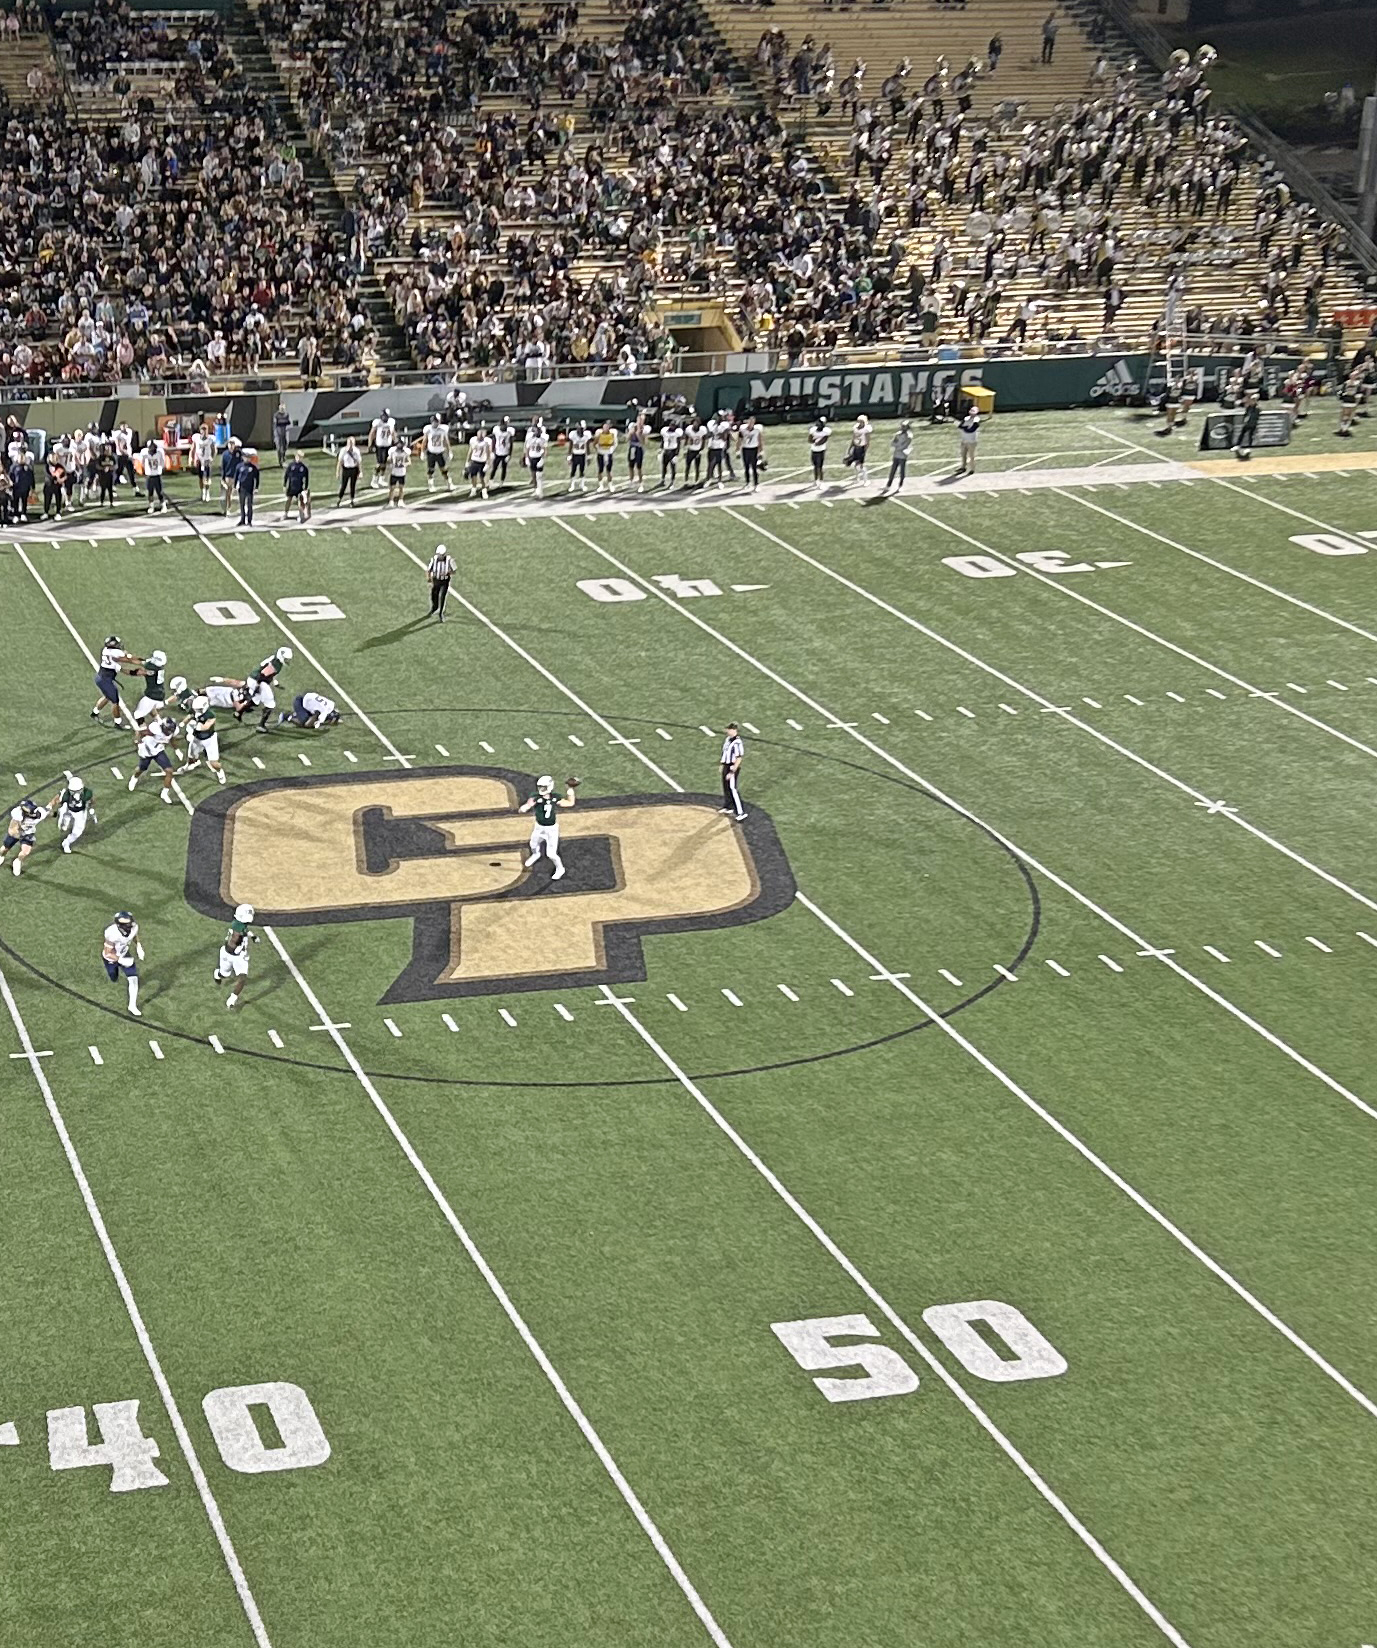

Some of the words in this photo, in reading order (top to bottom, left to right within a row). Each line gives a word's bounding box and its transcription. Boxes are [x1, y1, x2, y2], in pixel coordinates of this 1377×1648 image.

[1089, 383, 1140, 398] adidas
[769, 1299, 1069, 1404] 50
[45, 1381, 332, 1492] 40
